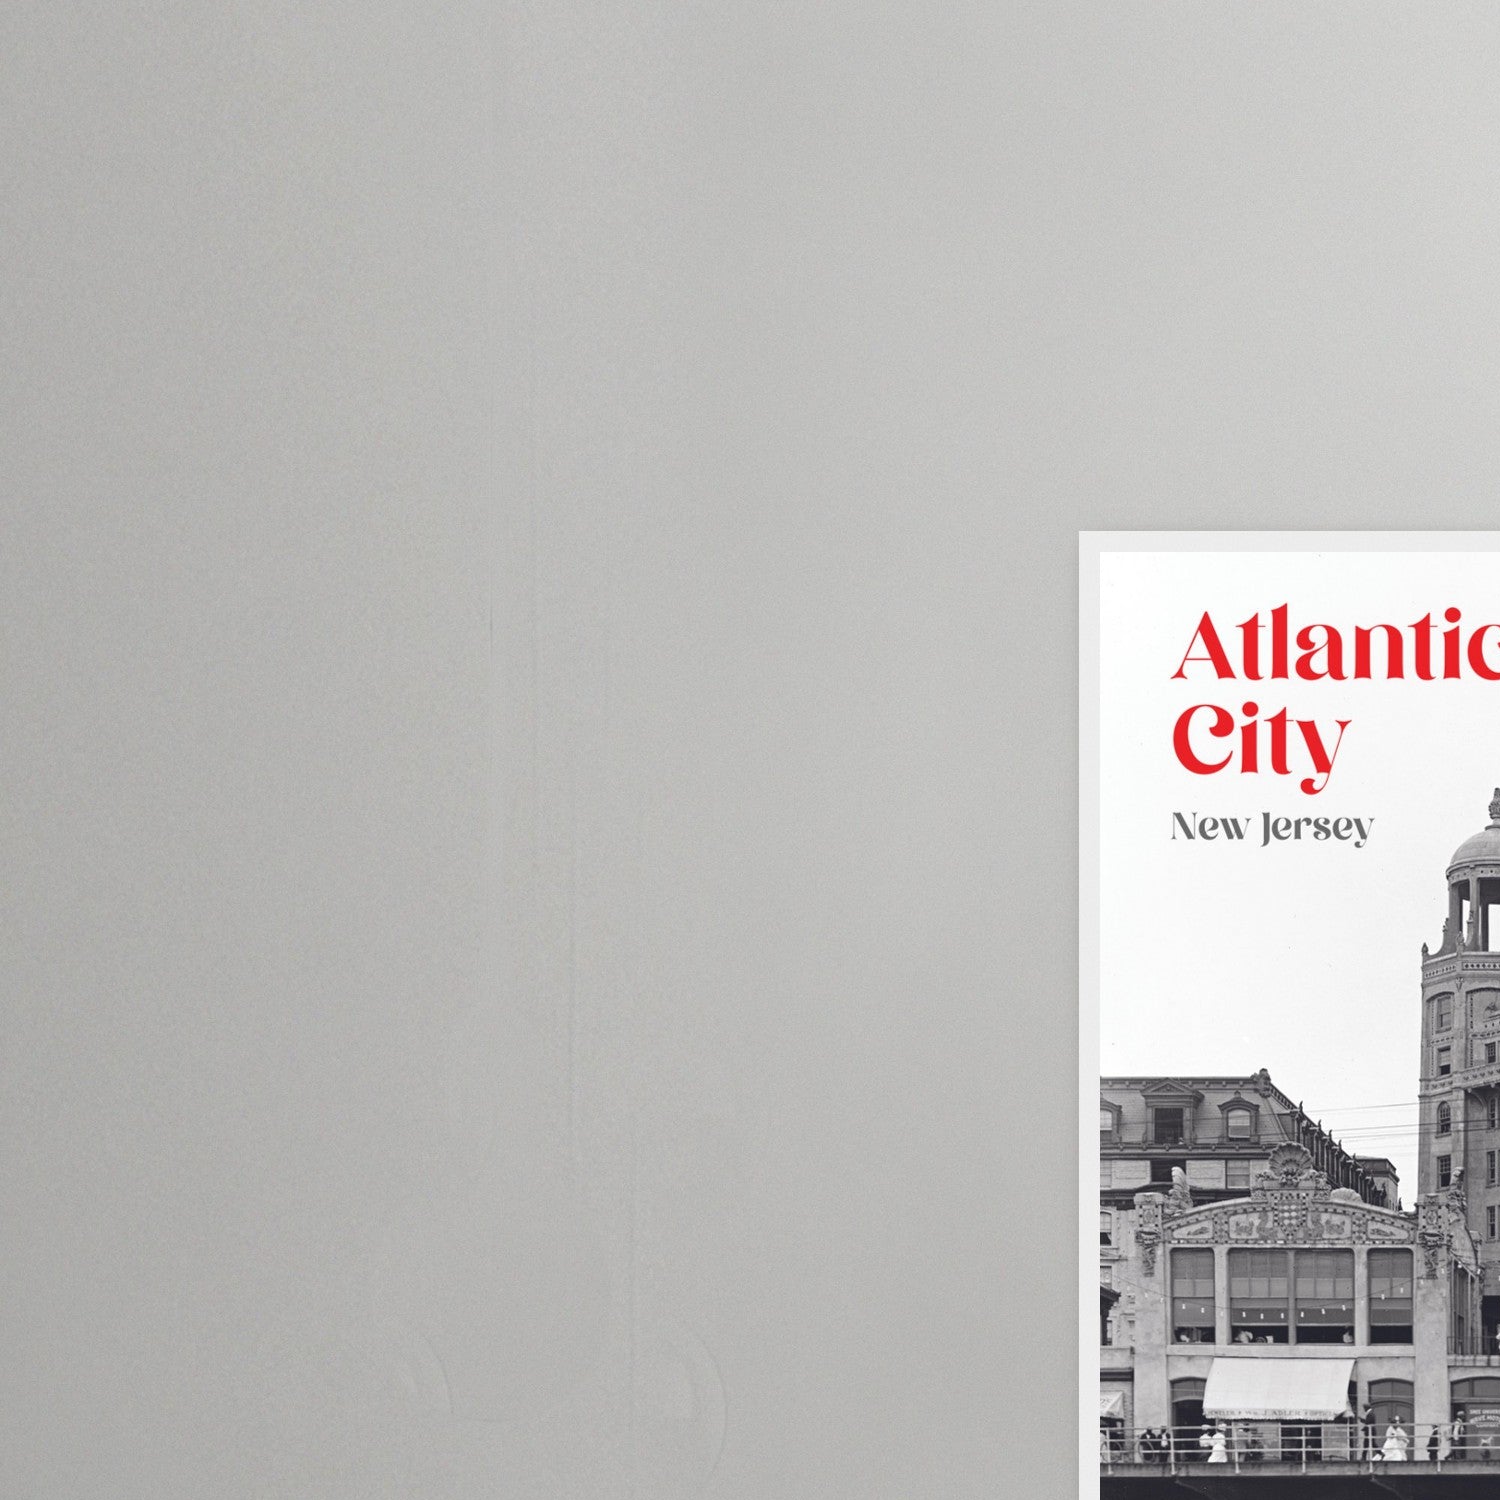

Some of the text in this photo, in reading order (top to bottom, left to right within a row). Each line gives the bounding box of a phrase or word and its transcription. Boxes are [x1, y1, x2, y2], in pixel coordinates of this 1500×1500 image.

[1173, 701, 1353, 795] City
[1171, 811, 1374, 849] New Jersey
